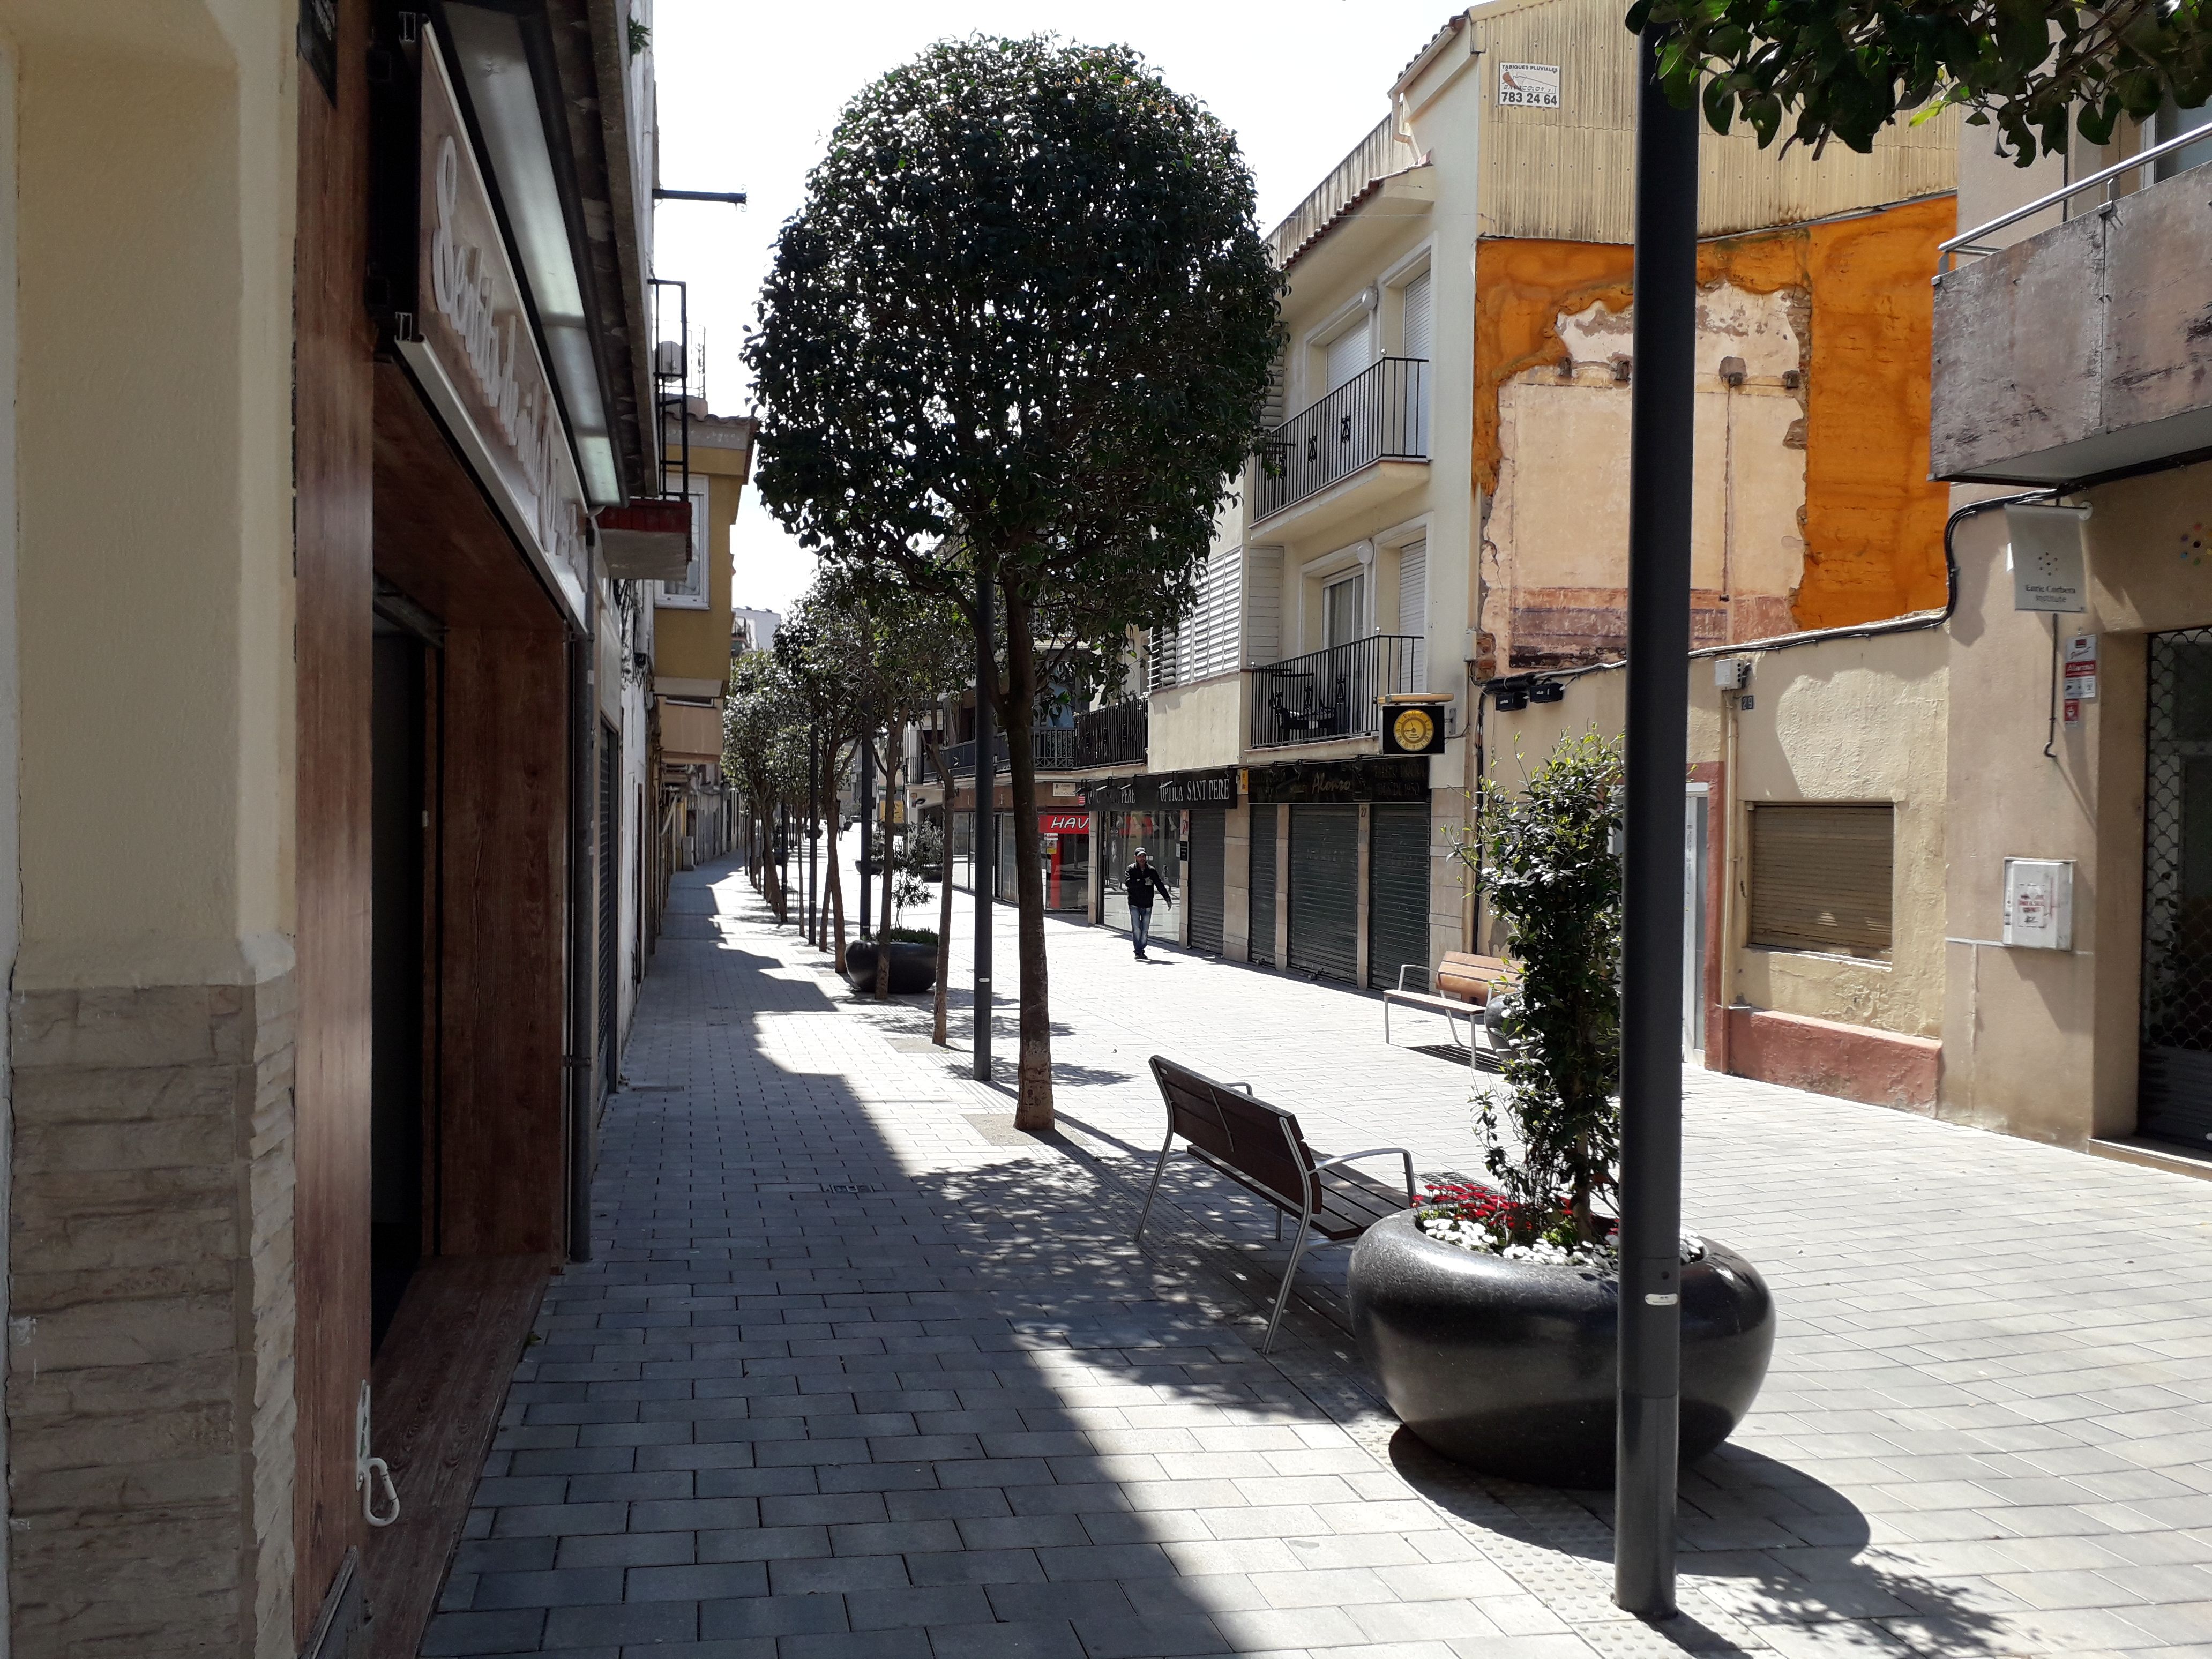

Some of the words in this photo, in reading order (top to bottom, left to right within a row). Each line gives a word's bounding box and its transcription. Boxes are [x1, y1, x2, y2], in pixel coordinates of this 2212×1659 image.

[1501, 92, 1522, 102] 783
[1527, 93, 1540, 103] 24
[1544, 94, 1557, 105] 64
[1742, 697, 1753, 709] 29
[1187, 780, 1207, 801] SANT
[1209, 779, 1229, 799] PERE
[1051, 816, 1089, 829] HAV
